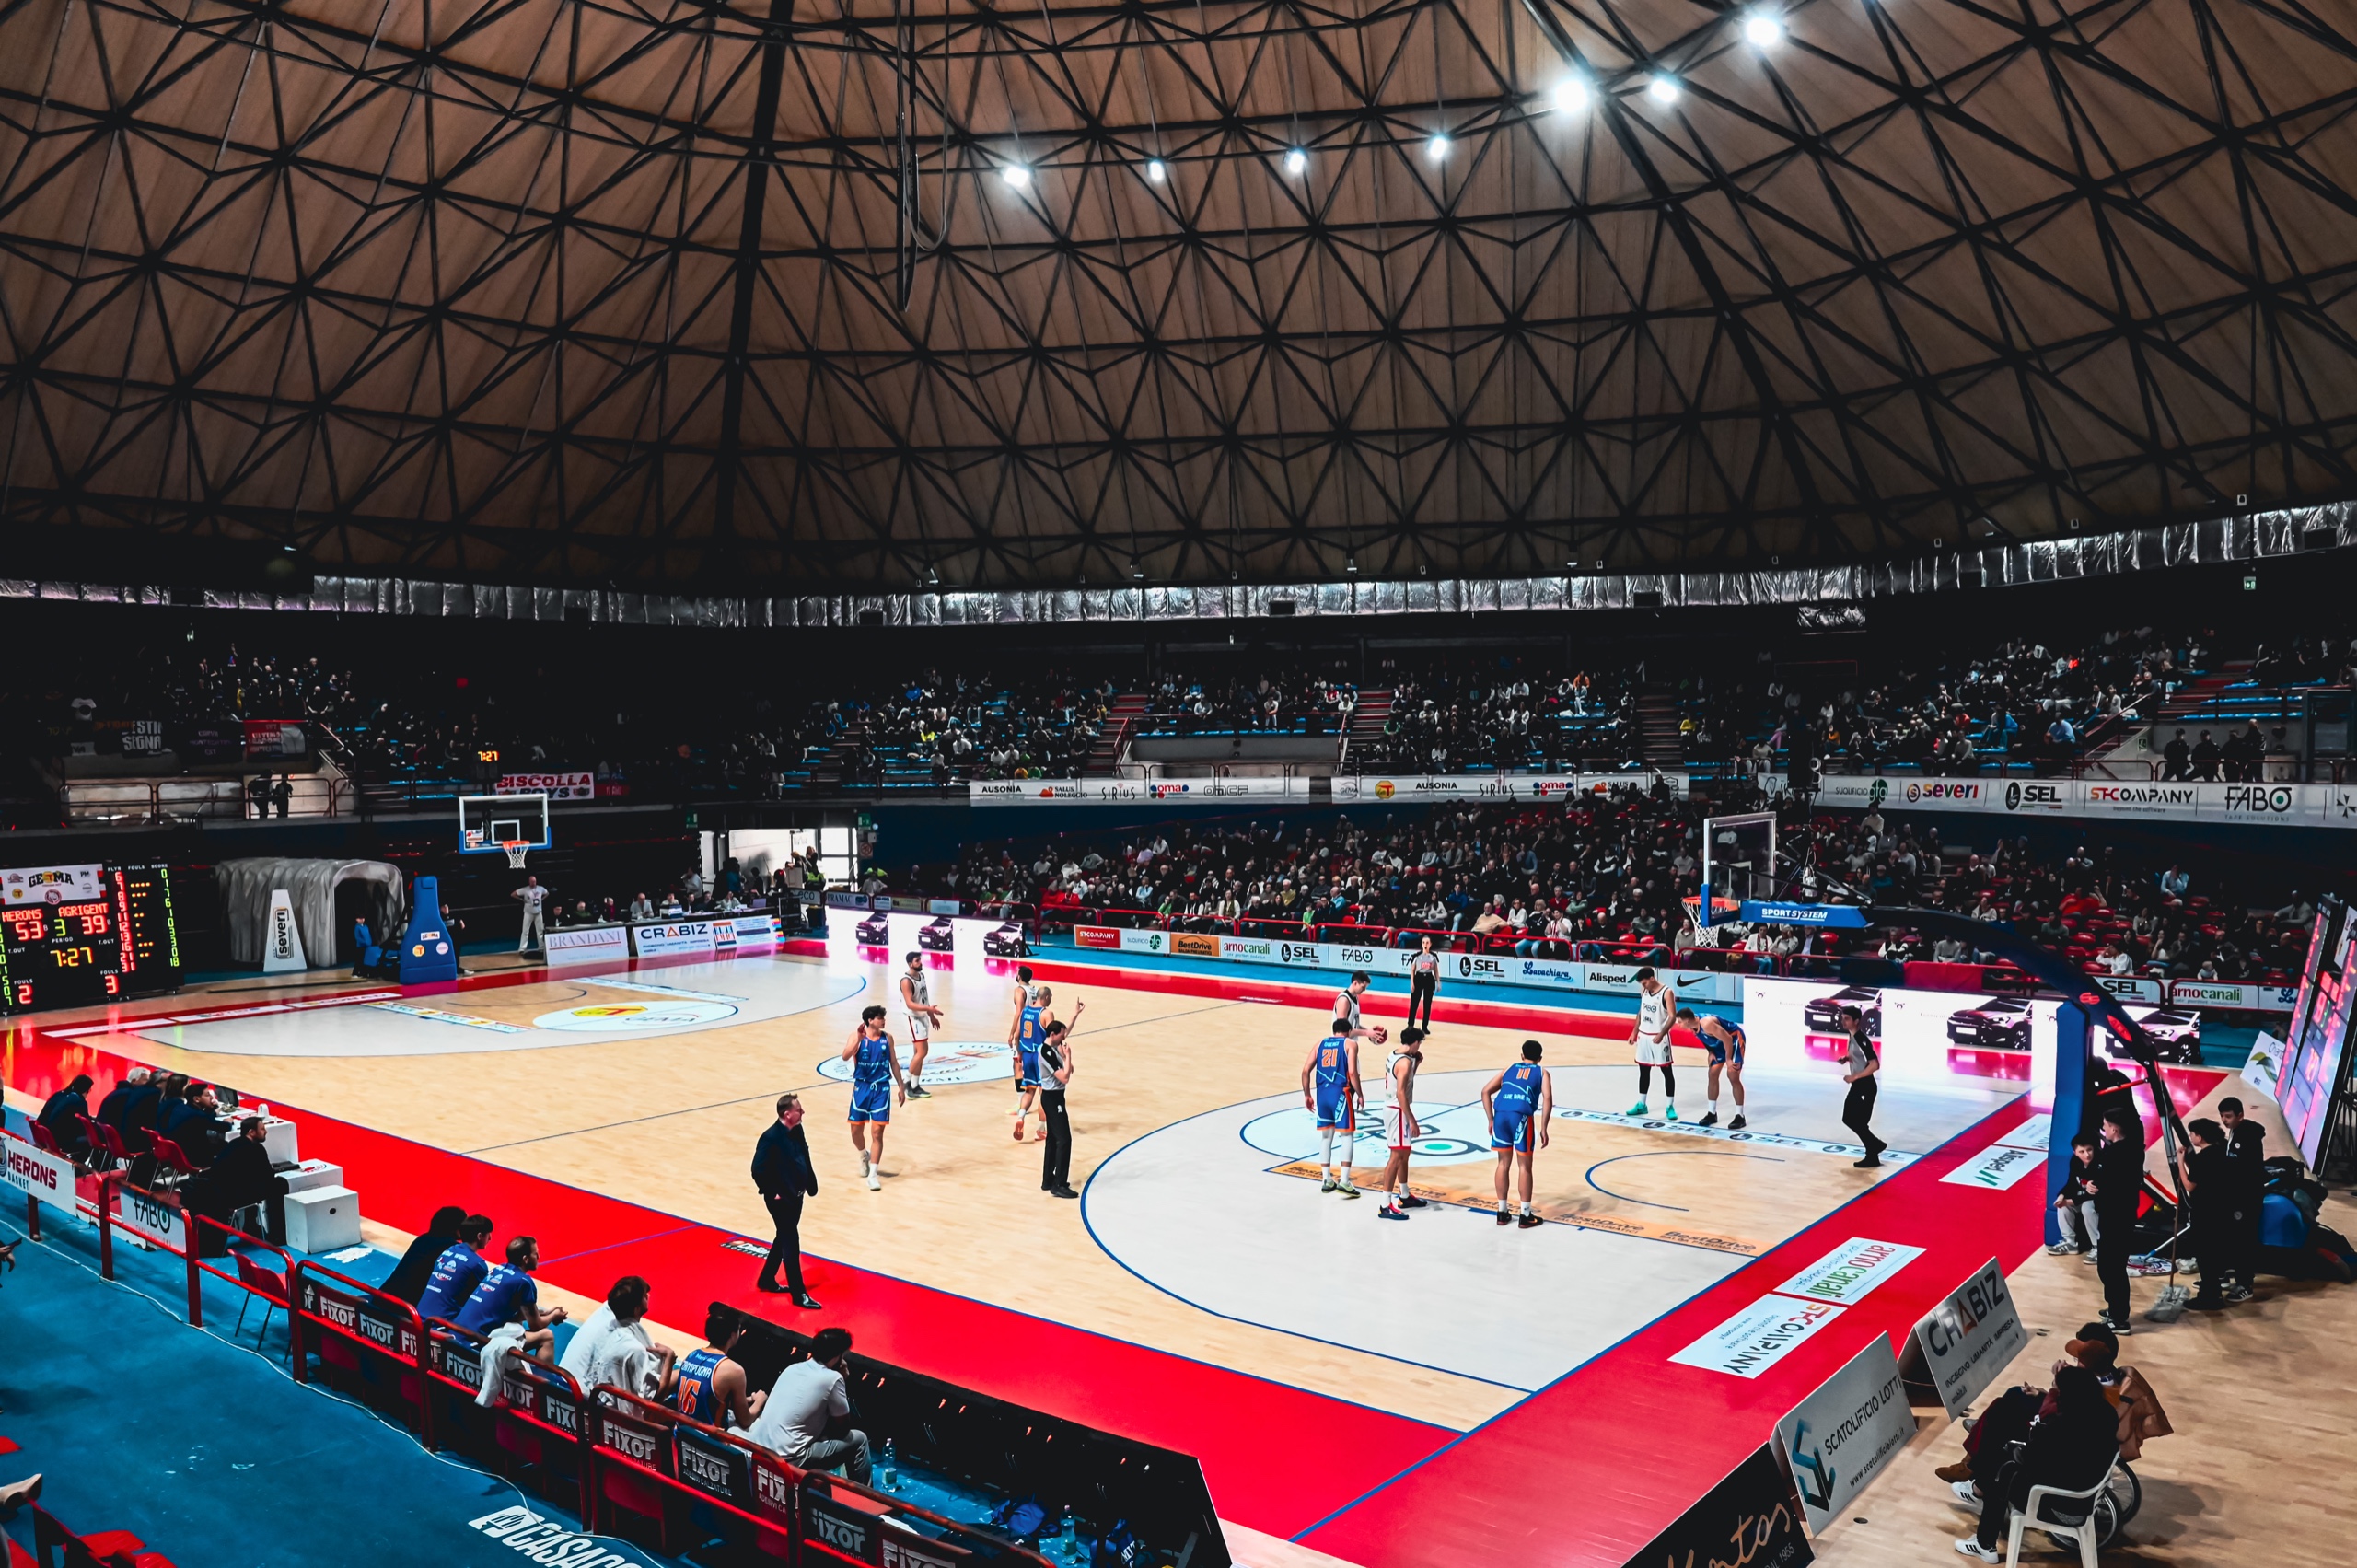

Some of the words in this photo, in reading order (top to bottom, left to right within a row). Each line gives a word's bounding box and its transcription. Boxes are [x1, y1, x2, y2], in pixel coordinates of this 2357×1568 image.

[478, 750, 500, 761] 7:27
[497, 775, 591, 788] BISCOLLA
[1157, 784, 1182, 793] oma
[1415, 782, 1457, 790] AUSONIA
[1539, 782, 1565, 790] oma
[1922, 784, 1979, 799] severi
[2023, 785, 2062, 803] SEL
[2224, 786, 2293, 813] FABO
[115, 871, 122, 881] 6
[160, 868, 168, 879] 0
[118, 891, 125, 901] 8
[165, 898, 171, 908] 6
[2, 908, 43, 922] HERONS
[58, 903, 109, 917] AGRIGENT
[119, 901, 126, 912] 9
[1761, 908, 1791, 917] SPORT
[1791, 909, 1828, 919] SYSTEM
[81, 915, 108, 935] 39
[118, 912, 129, 922] 11
[168, 918, 174, 927] 0
[16, 921, 44, 940] 53
[53, 918, 66, 936] 3
[119, 922, 130, 932] 12
[277, 912, 288, 954] severi
[640, 923, 709, 940] CRABIZ
[121, 932, 131, 942] 13
[548, 931, 622, 948] BRANDANI
[1178, 940, 1213, 950] BestDrive
[50, 947, 93, 967] 7:27
[1224, 942, 1271, 955] arnocanali
[1293, 947, 1319, 958] SEL
[1341, 948, 1374, 963] FABO
[1473, 959, 1504, 972] SEL
[105, 975, 119, 994] 3
[1589, 972, 1627, 983] Alisped
[18, 984, 32, 1005] 2
[2102, 980, 2144, 995] SEL
[2172, 987, 2241, 1002] arnocanali
[1023, 1020, 1033, 1039] 9
[1321, 1048, 1339, 1067] 21
[1515, 1067, 1531, 1080] 11
[1983, 1149, 2028, 1172] Alisped
[7, 1150, 57, 1190] HERONS
[7, 1171, 29, 1191] BASKET
[134, 1191, 171, 1233] FABO
[1805, 1244, 1897, 1299] arnocanali
[319, 1296, 356, 1327] Fixor
[1928, 1269, 2005, 1357] CRABIZ
[359, 1312, 394, 1345] Fixor
[1945, 1361, 1970, 1388] INGEGNO
[1993, 1318, 2014, 1342] IMPRESA
[503, 1376, 534, 1409] ixor
[678, 1376, 702, 1415] 16
[1824, 1395, 1879, 1456] SCATOLIFICIO
[1878, 1373, 1903, 1406] LOTTI
[602, 1420, 656, 1461] Fixor
[681, 1440, 730, 1486] Fixor
[1849, 1427, 1906, 1488] www.scatolificiolotti.it
[1778, 1542, 1795, 1563] 1955
